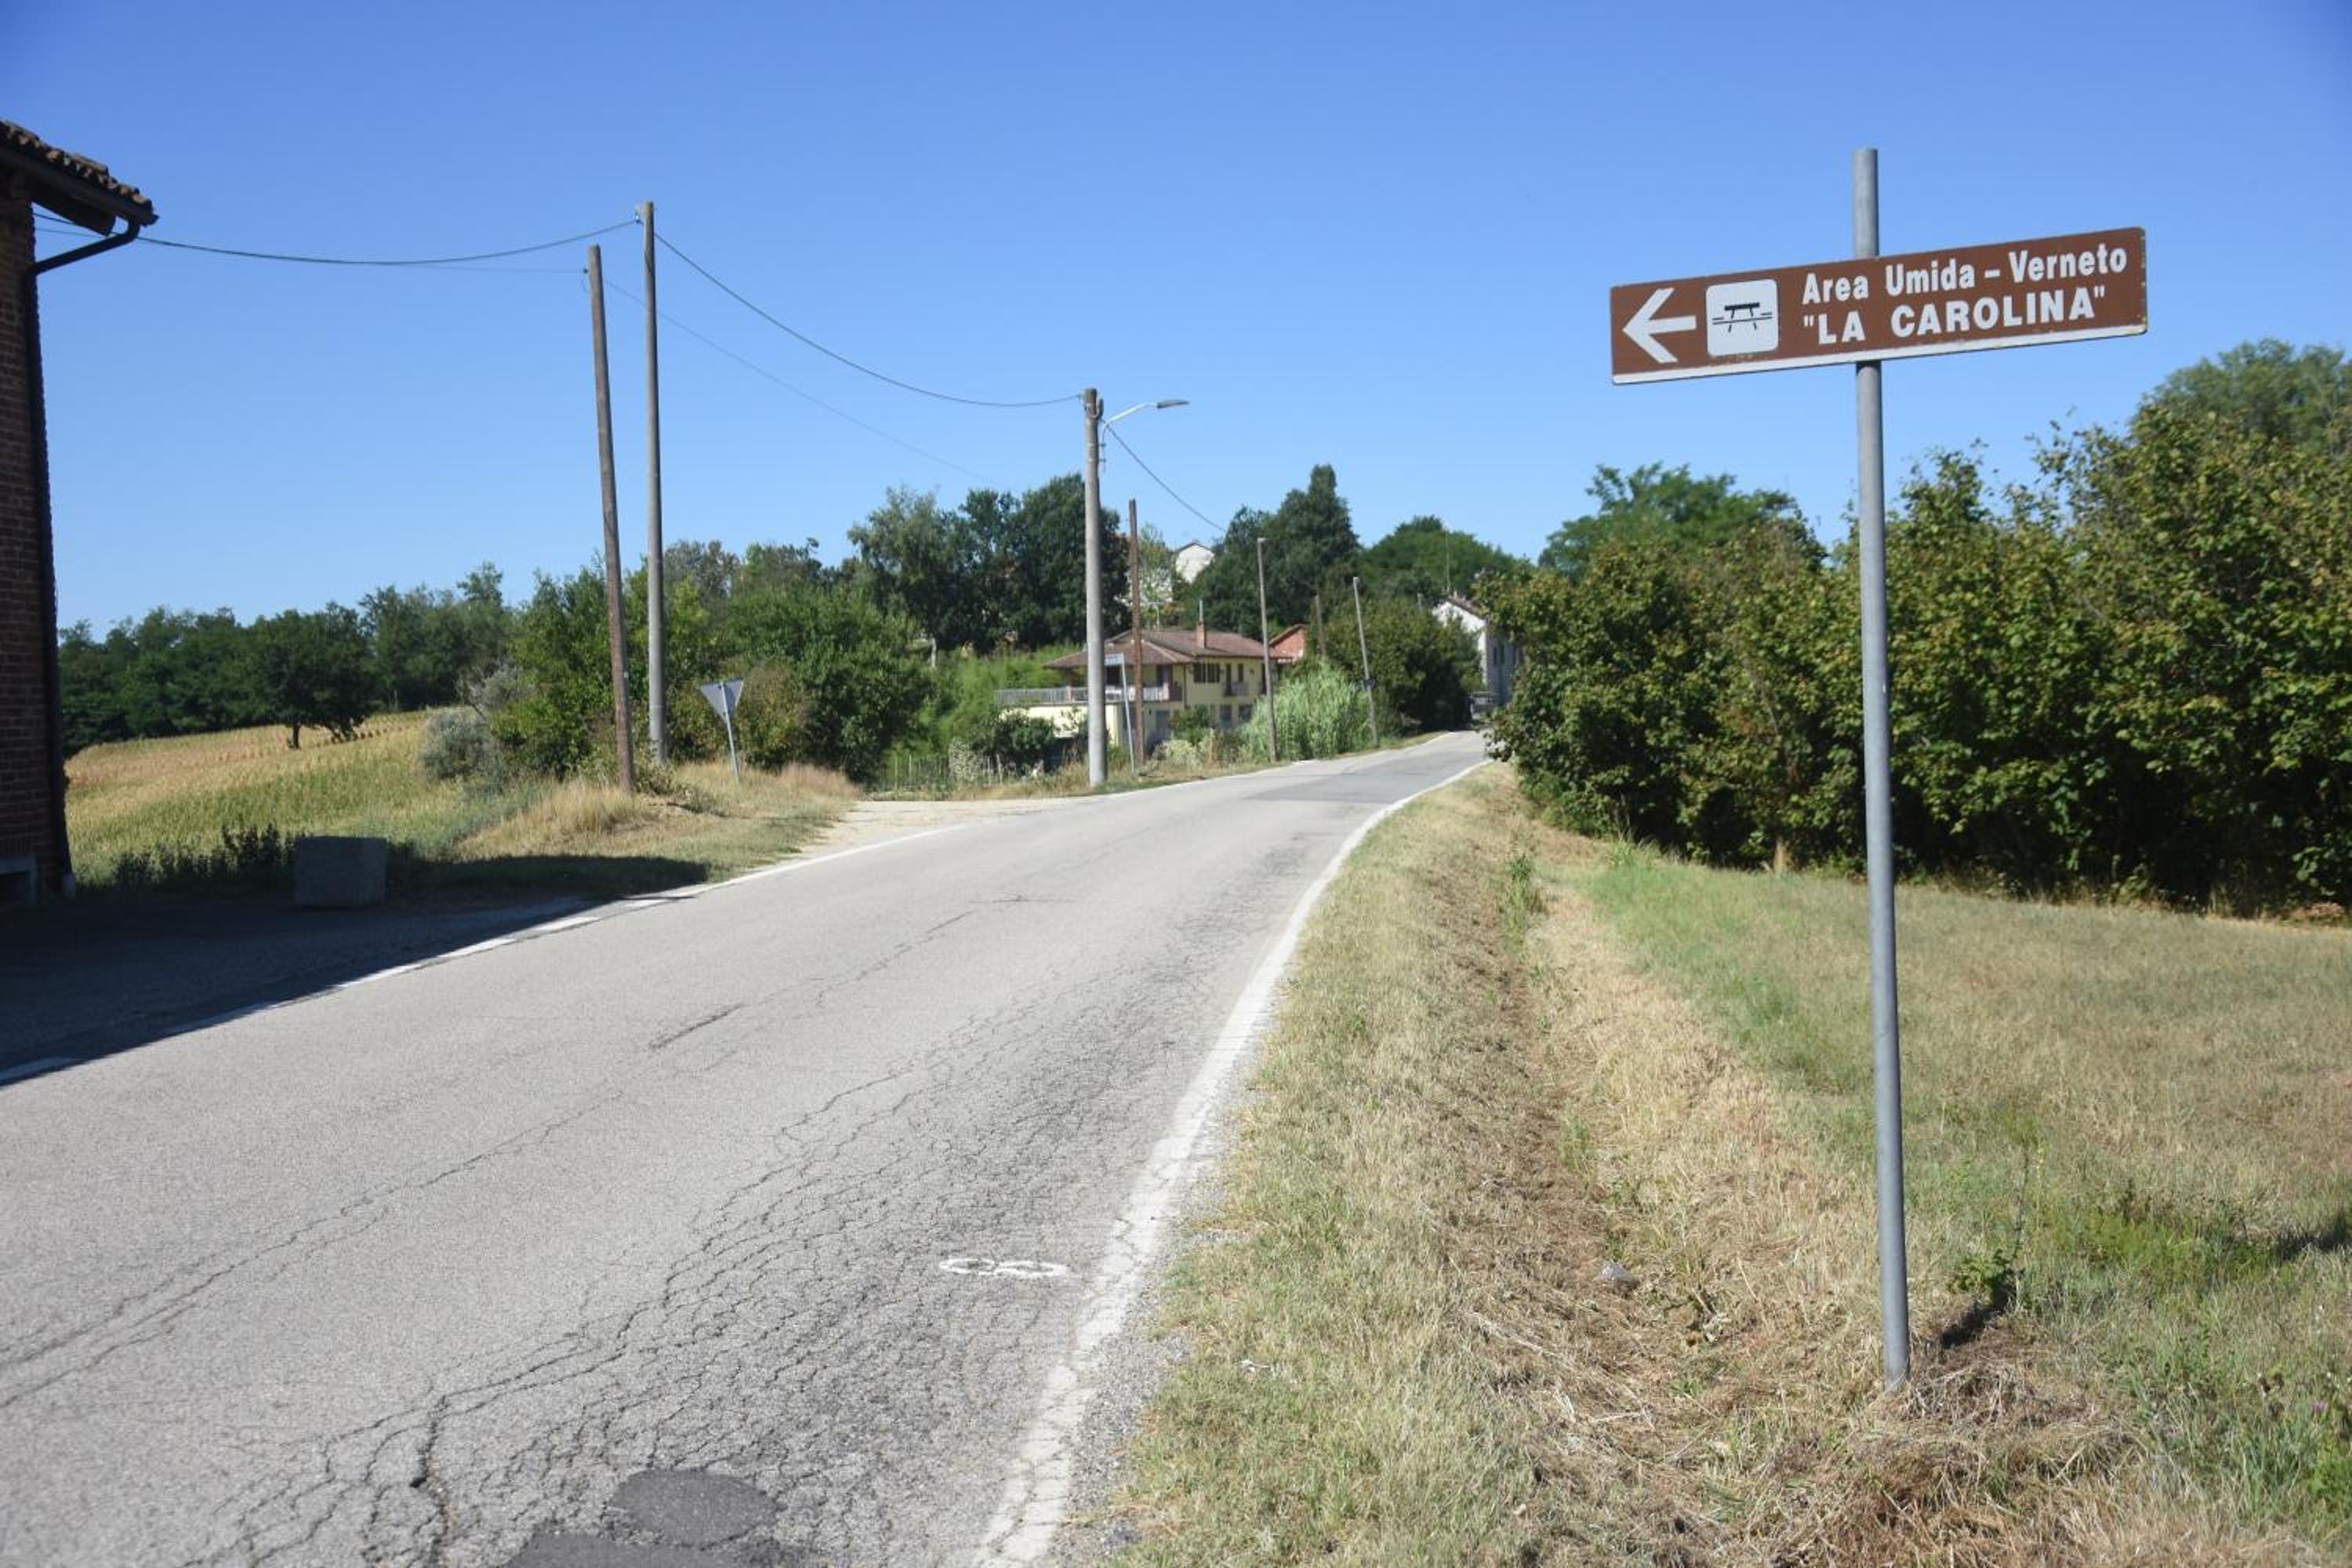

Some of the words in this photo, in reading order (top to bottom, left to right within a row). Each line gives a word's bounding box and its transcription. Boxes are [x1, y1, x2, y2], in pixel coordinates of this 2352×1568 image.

[1802, 273, 1869, 305] Area
[1886, 259, 1975, 296] Umida
[2009, 243, 2127, 283] Verneto
[1803, 310, 1866, 345] "LA
[1890, 285, 2105, 338] CAROLINA"
